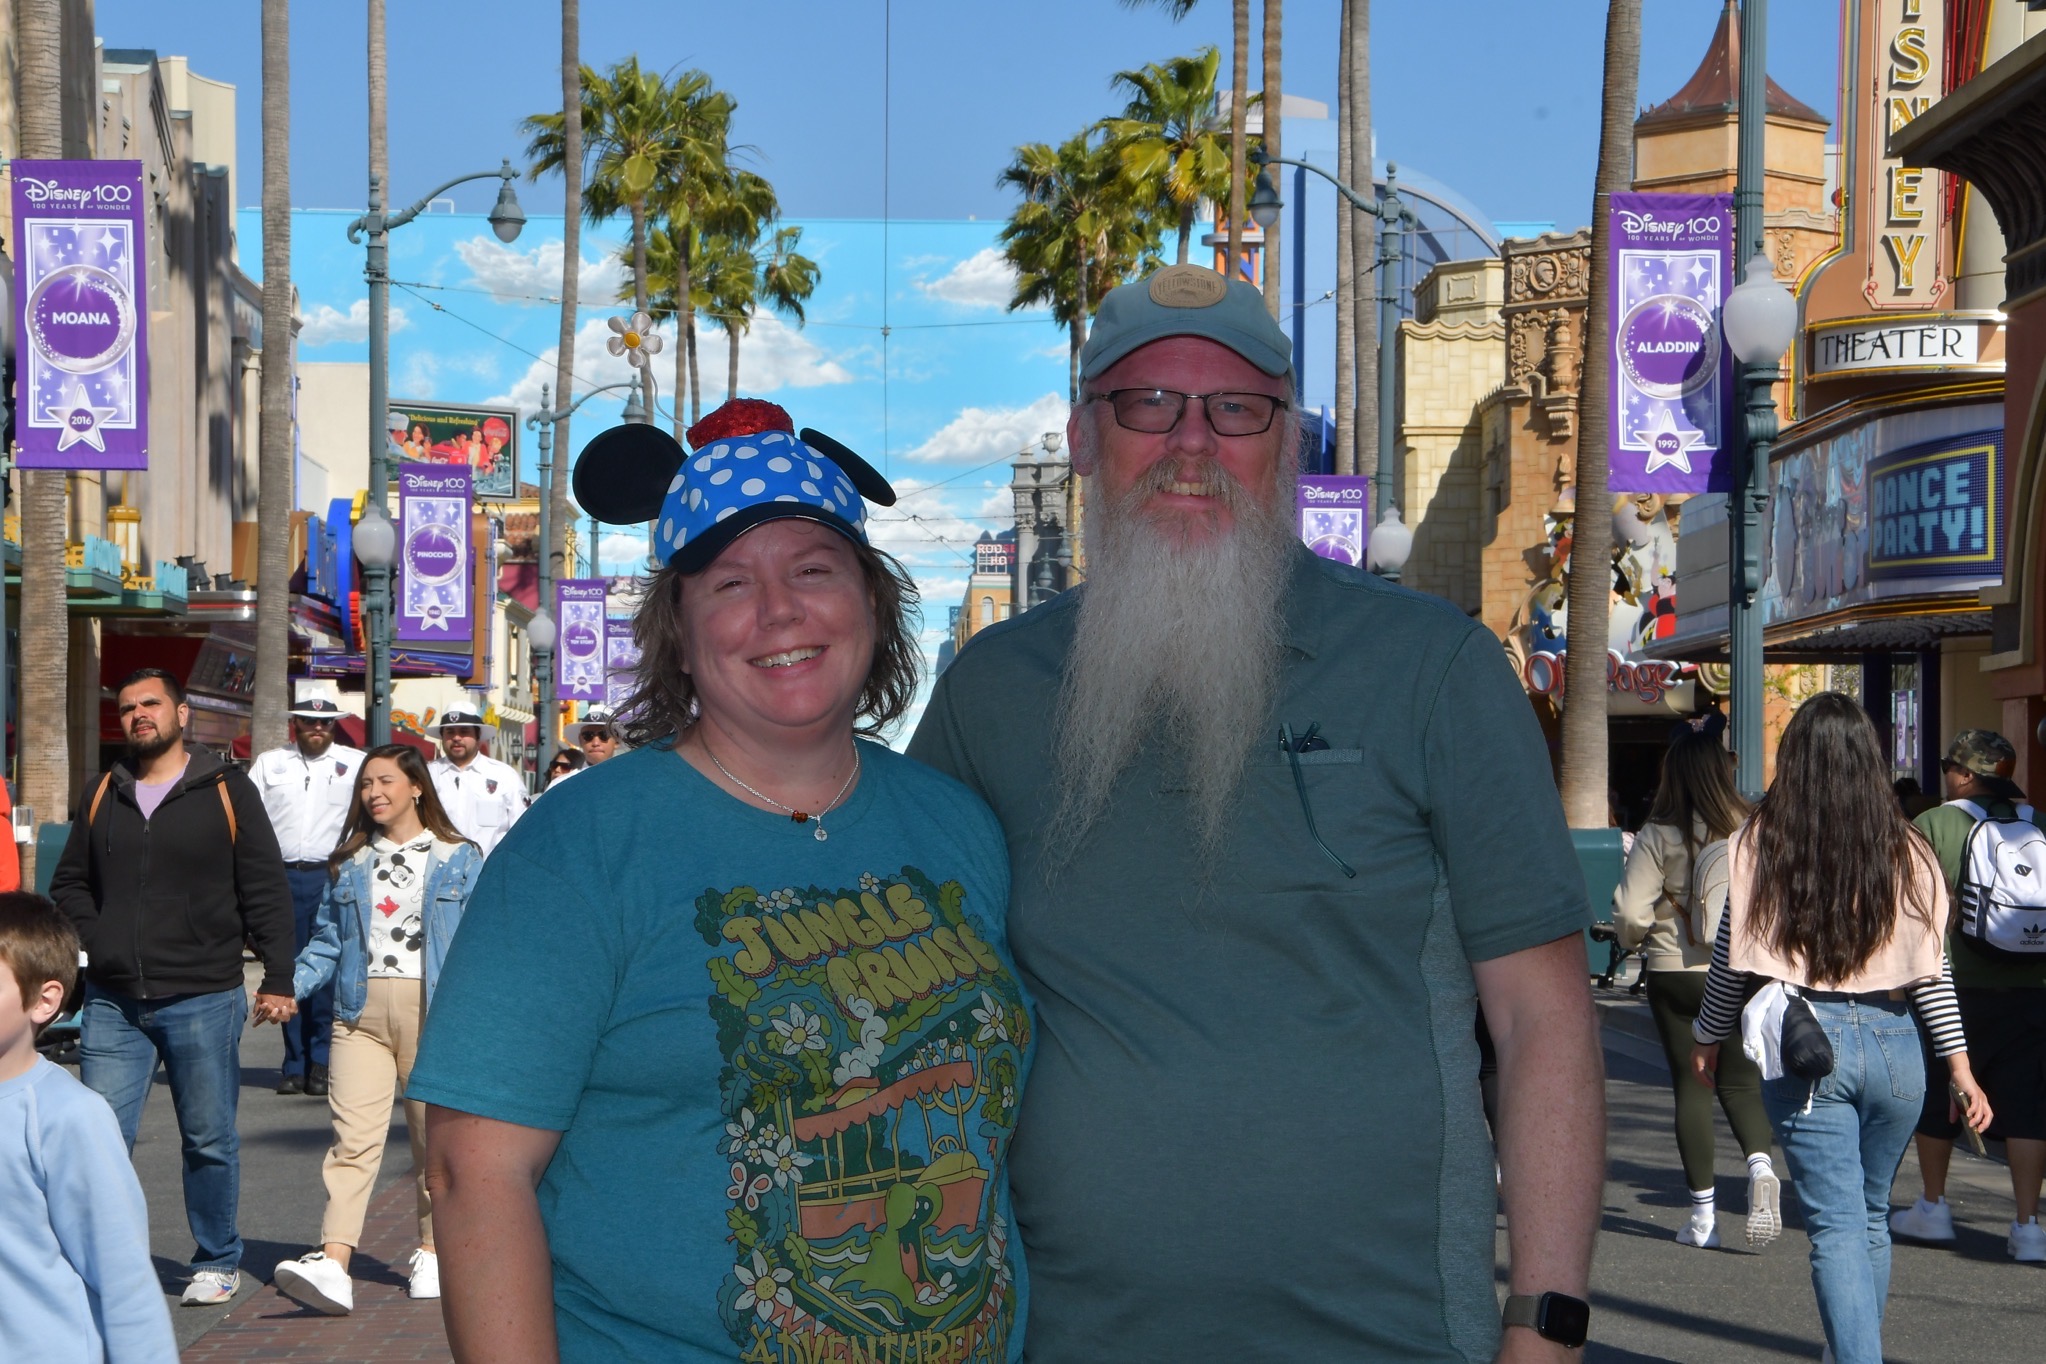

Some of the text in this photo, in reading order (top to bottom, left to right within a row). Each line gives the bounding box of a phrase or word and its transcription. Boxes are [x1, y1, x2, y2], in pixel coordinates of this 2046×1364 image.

[1884, 0, 1932, 290] SNEY
[92, 184, 132, 202] 100
[1686, 216, 1720, 234] 100
[1154, 278, 1217, 295] YELLOWSTONE
[52, 312, 111, 325] MOANA
[1637, 341, 1700, 353] ALADDIN
[1820, 327, 1964, 365] THEATER
[71, 416, 92, 425] 2016
[1657, 439, 1678, 449] 1992
[444, 478, 466, 489] 100
[1874, 461, 1971, 517] DANCE
[1341, 488, 1363, 499] 100
[1873, 505, 1985, 557] PARTY!
[417, 551, 454, 559] PINOCCHIO
[588, 588, 604, 596] 100
[721, 883, 934, 978] JUNGLE
[826, 922, 1000, 1022] CRUISE
